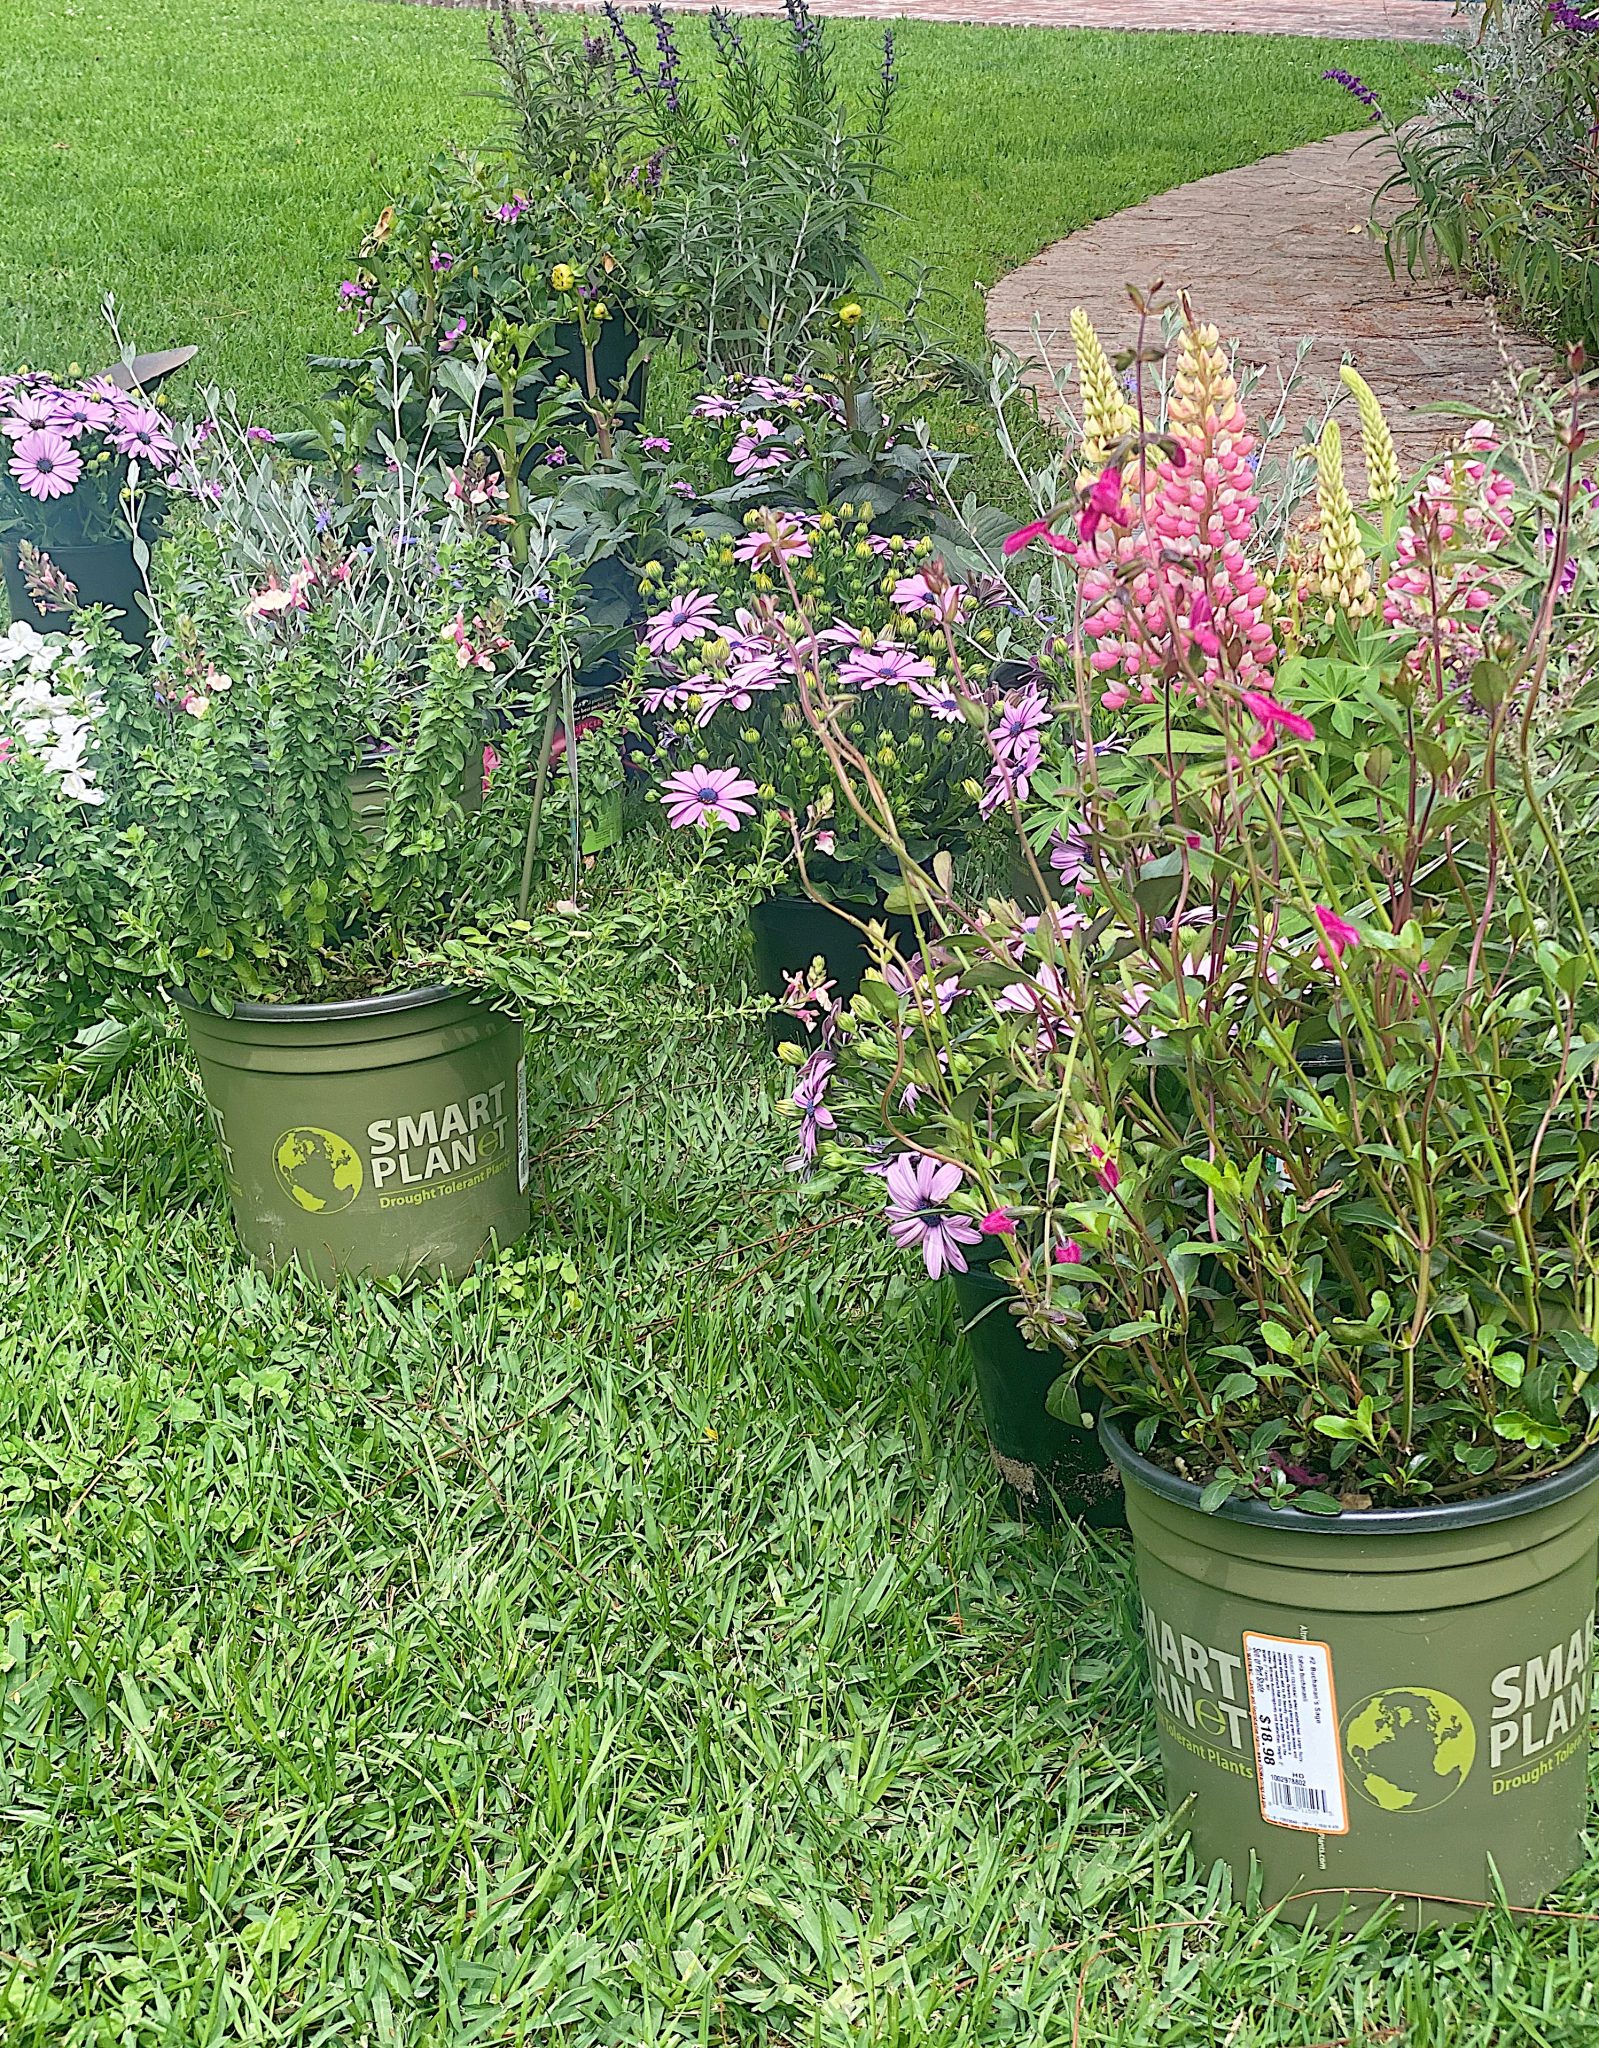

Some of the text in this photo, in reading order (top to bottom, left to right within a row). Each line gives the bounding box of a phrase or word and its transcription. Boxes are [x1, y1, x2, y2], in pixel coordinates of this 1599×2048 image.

[367, 1081, 506, 1155] SMART
[379, 1188, 437, 1209] Drought
[438, 1171, 485, 1196] Tolerant
[1140, 1594, 1242, 1701] MART
[1491, 1609, 1595, 1719] SMAR
[1258, 1714, 1275, 1765] $18.98
[1313, 1706, 1322, 1724] Sage
[1490, 1671, 1588, 1769] PLAN
[1164, 1719, 1254, 1779] Tolerant Plants
[1492, 1757, 1553, 1796] Drought
